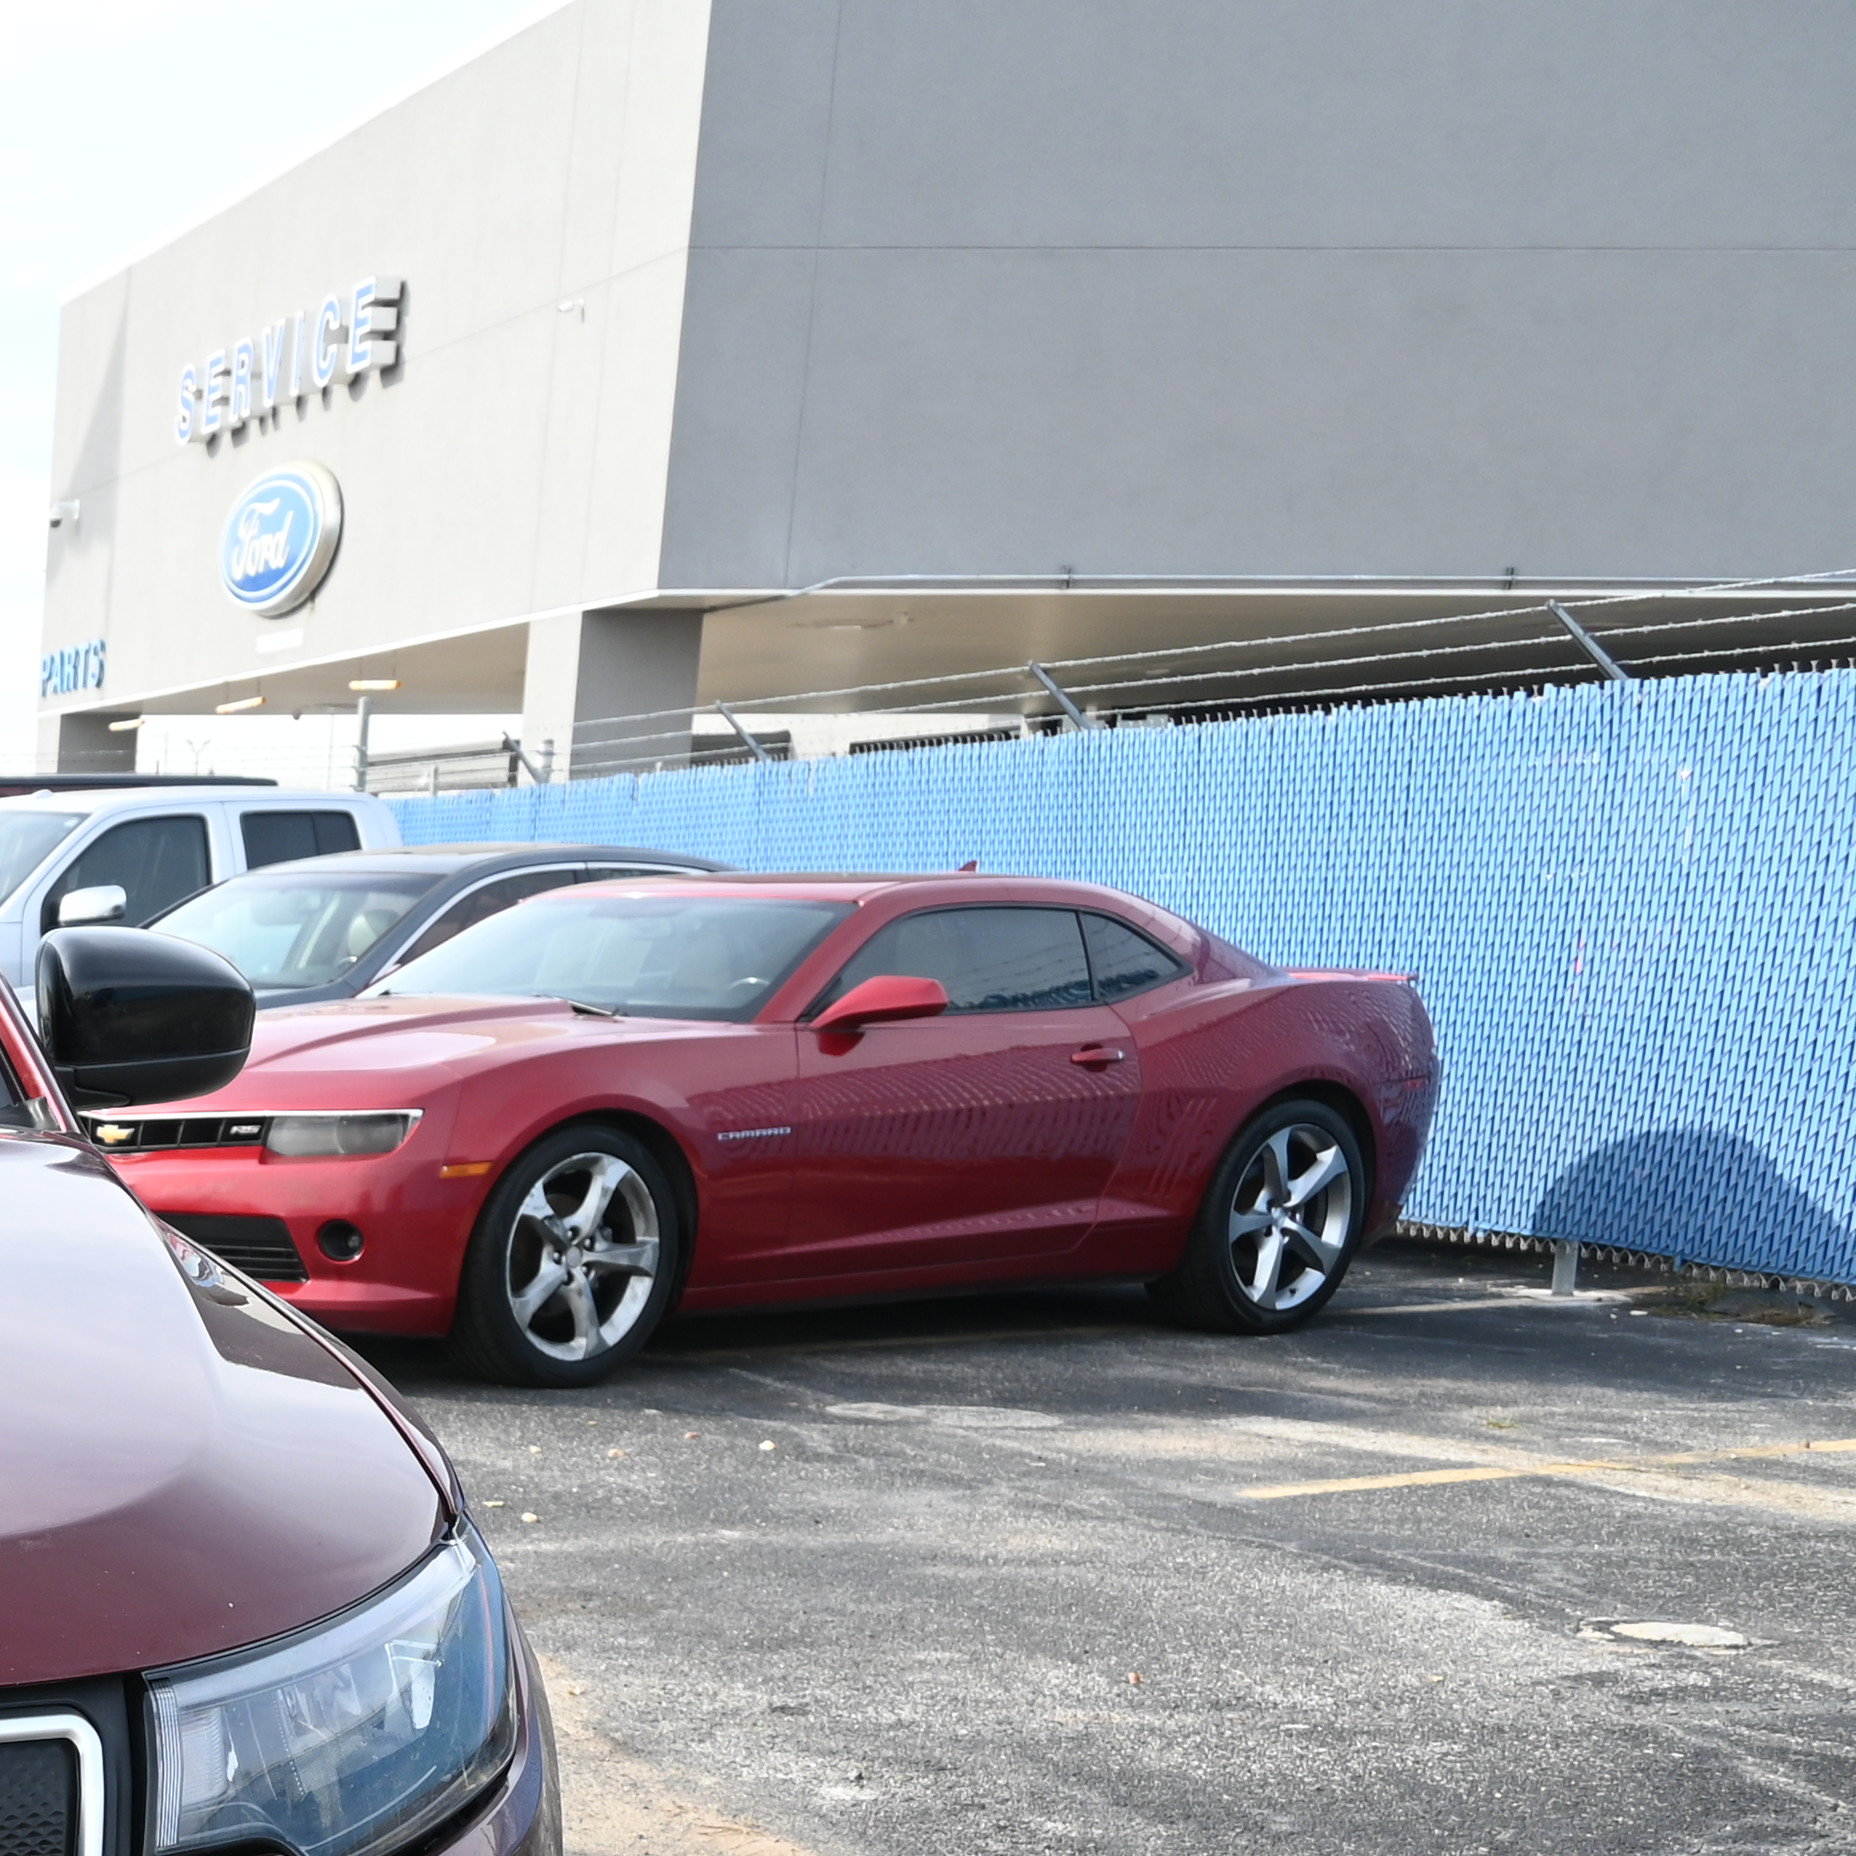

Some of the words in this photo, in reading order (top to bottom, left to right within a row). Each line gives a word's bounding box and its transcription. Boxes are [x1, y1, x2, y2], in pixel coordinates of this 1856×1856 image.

[175, 275, 400, 446] SERVICE
[231, 497, 295, 582] Ford
[40, 637, 106, 698] PARTS
[717, 1126, 792, 1141] CAMARO
